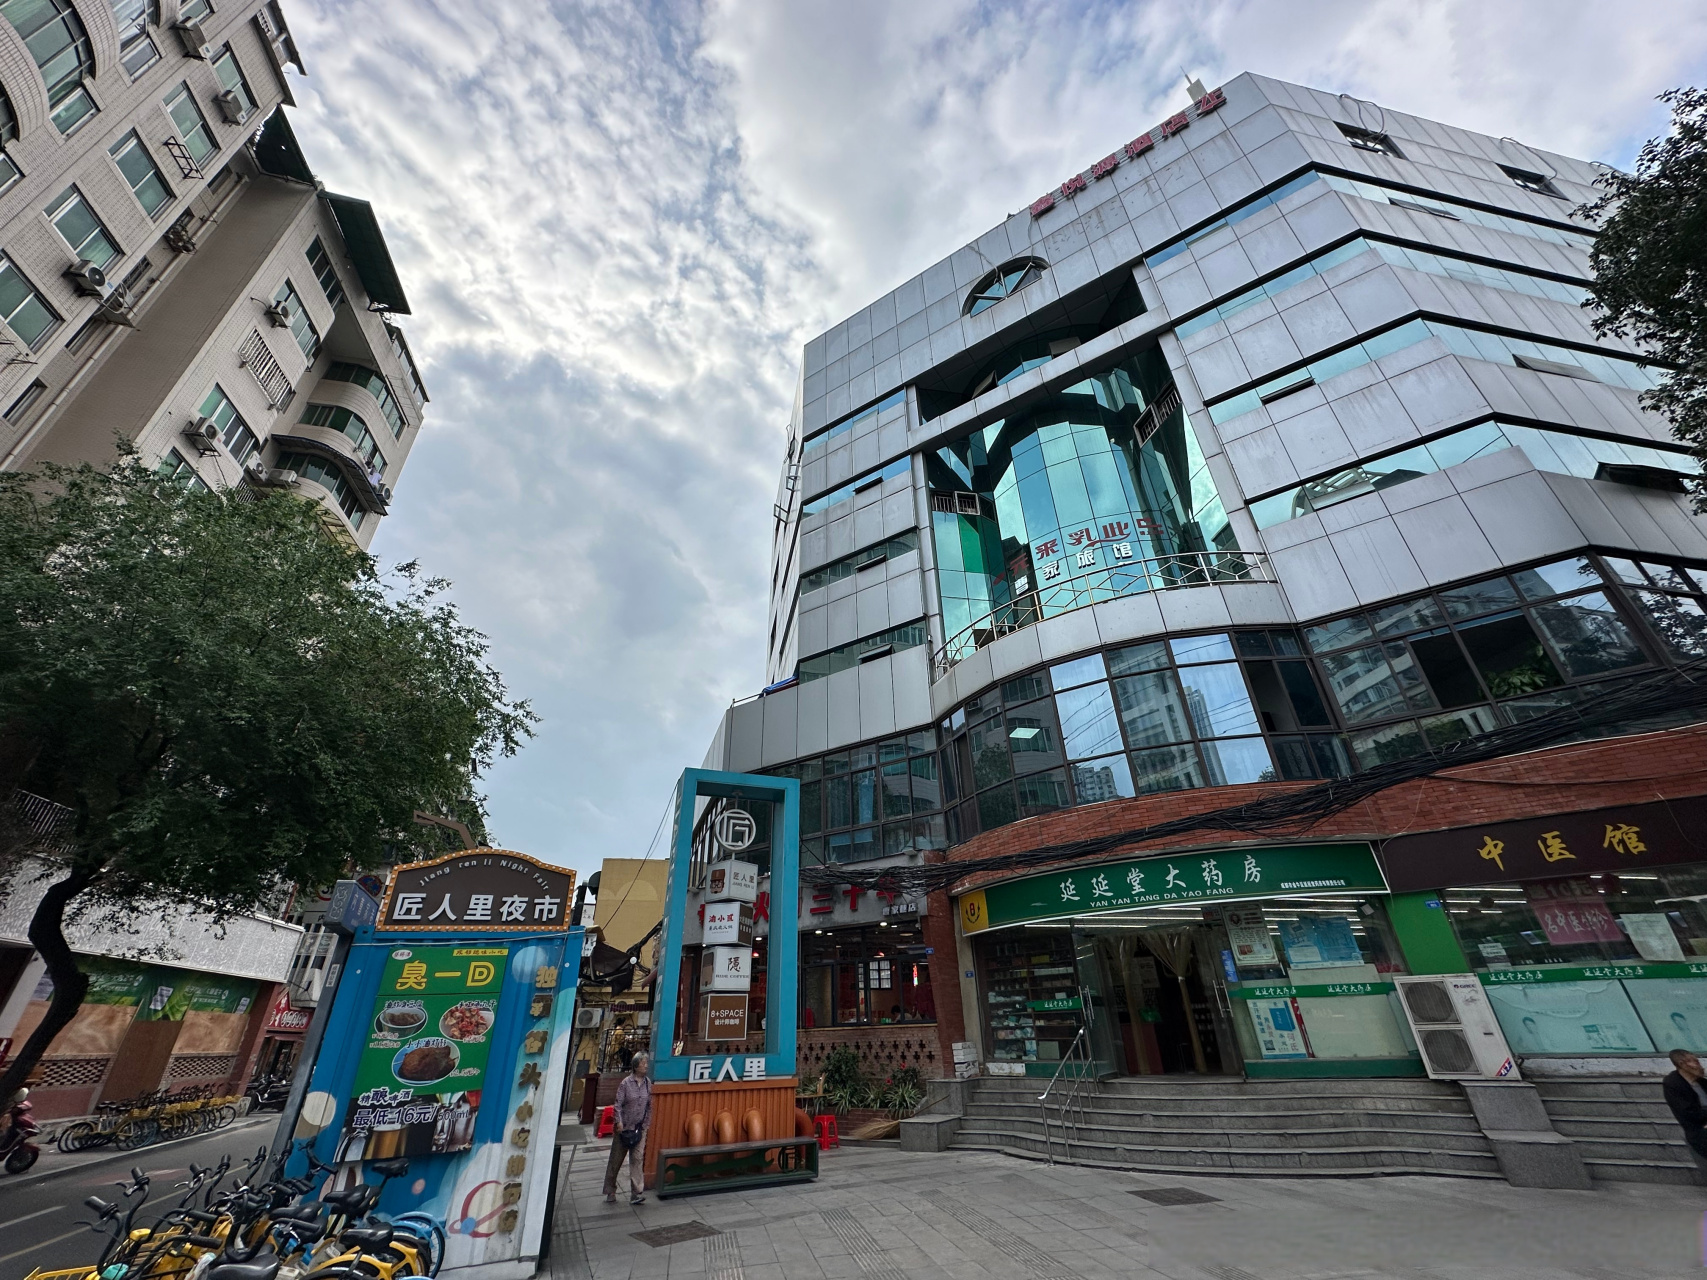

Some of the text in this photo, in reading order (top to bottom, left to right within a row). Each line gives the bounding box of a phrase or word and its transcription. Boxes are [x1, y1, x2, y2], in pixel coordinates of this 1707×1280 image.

[1477, 823, 1647, 871] 中医馆
[458, 860, 477, 868] ren
[499, 859, 530, 875] Night
[532, 872, 550, 891] Fair
[1059, 854, 1262, 902] 延延堂大药房
[392, 892, 561, 922] 匠人里夜市
[1090, 900, 1108, 908] YAN
[1112, 897, 1131, 905] YAN
[1134, 894, 1160, 903] TANG
[1182, 890, 1202, 898] YAO
[1206, 887, 1234, 896] FANG
[710, 1009, 744, 1018] 8+SPACE
[688, 1057, 766, 1083] 匠人里
[358, 1086, 414, 1106] 精酿啤酒
